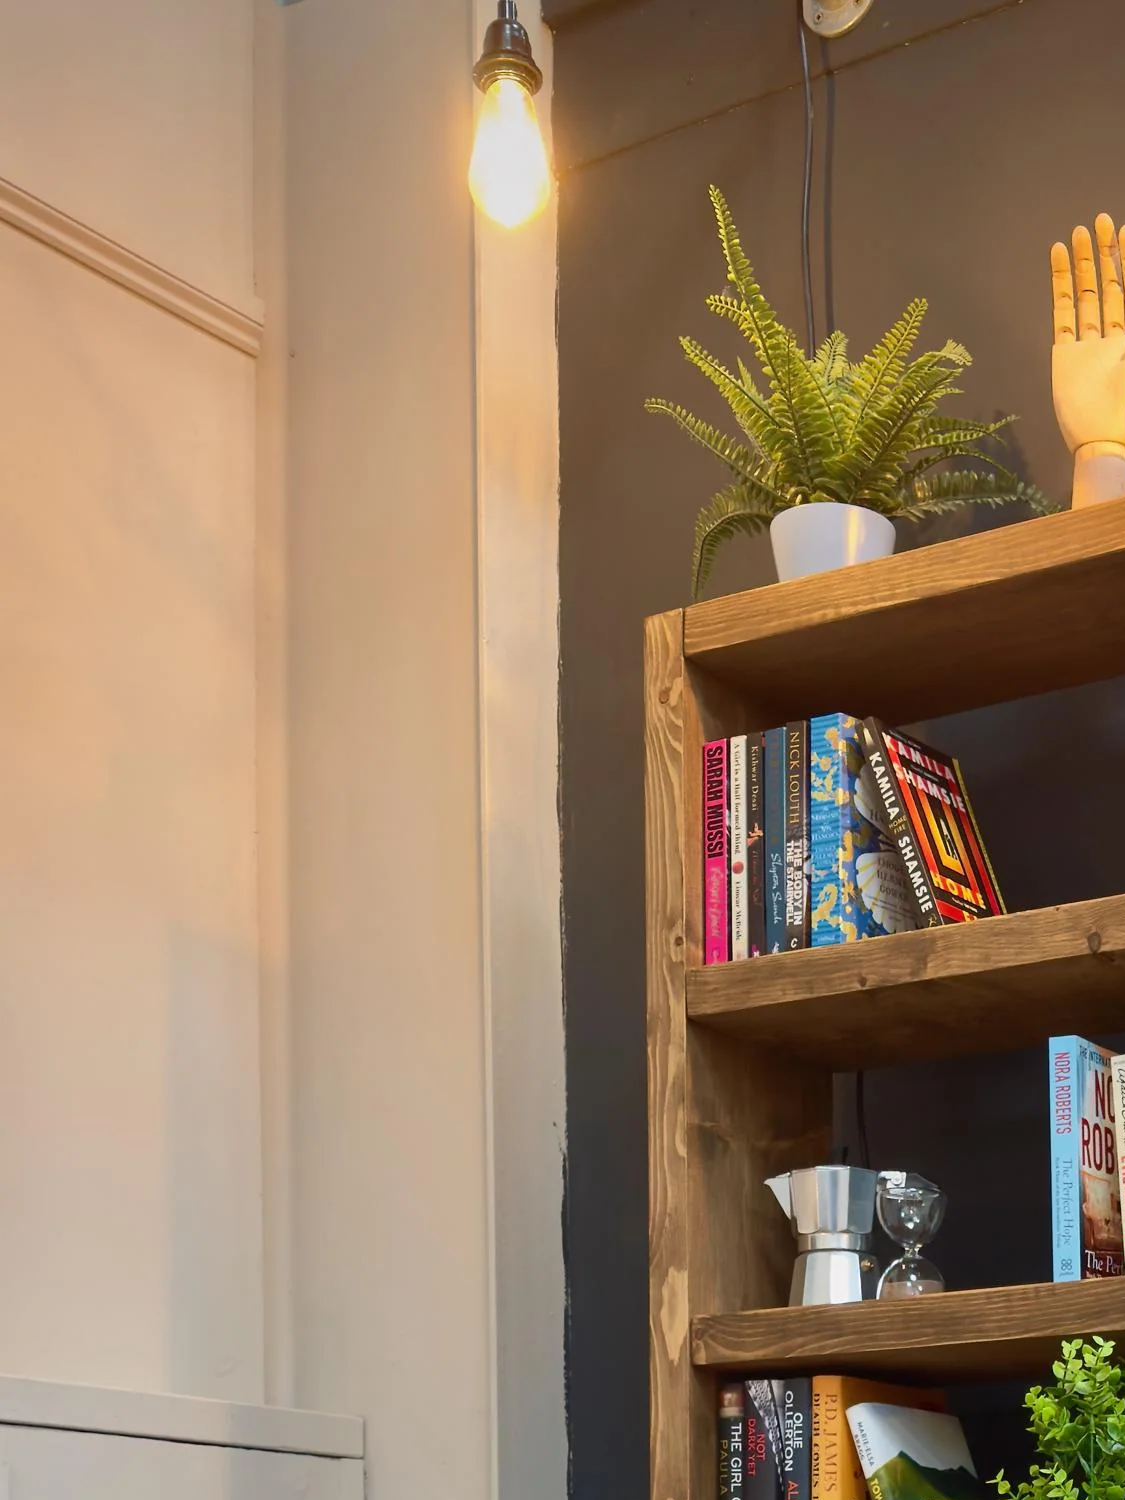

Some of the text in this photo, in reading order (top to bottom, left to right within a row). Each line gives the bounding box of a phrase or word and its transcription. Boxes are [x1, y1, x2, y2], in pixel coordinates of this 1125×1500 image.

[707, 746, 723, 801] SARAH
[789, 731, 800, 825] NICK LOUTH
[881, 731, 956, 784] KAMILA
[869, 752, 900, 821] KAMILA
[892, 762, 967, 814] SHAMSIE
[707, 804, 724, 859] MUSSI
[888, 814, 907, 835] HOME FIRE
[786, 840, 794, 927] THE STAIRWELL
[793, 839, 803, 926] THE BODY IN
[898, 835, 933, 913] SHAMSIE
[930, 869, 986, 910] HOME
[1054, 1052, 1072, 1135] NORA ROBERTS
[1061, 1159, 1074, 1245] The Perfect Hope
[1085, 1249, 1103, 1271] The
[730, 1422, 742, 1453] THE
[747, 1418, 756, 1476] DARK YET
[756, 1433, 766, 1461] NOT
[784, 1390, 794, 1472] OLLERTON
[793, 1412, 804, 1449] OLLIE
[719, 1440, 729, 1495] PAULA
[730, 1457, 742, 1493] GIRL
[812, 1443, 820, 1488] COMES
[823, 1429, 838, 1493] JAMES
